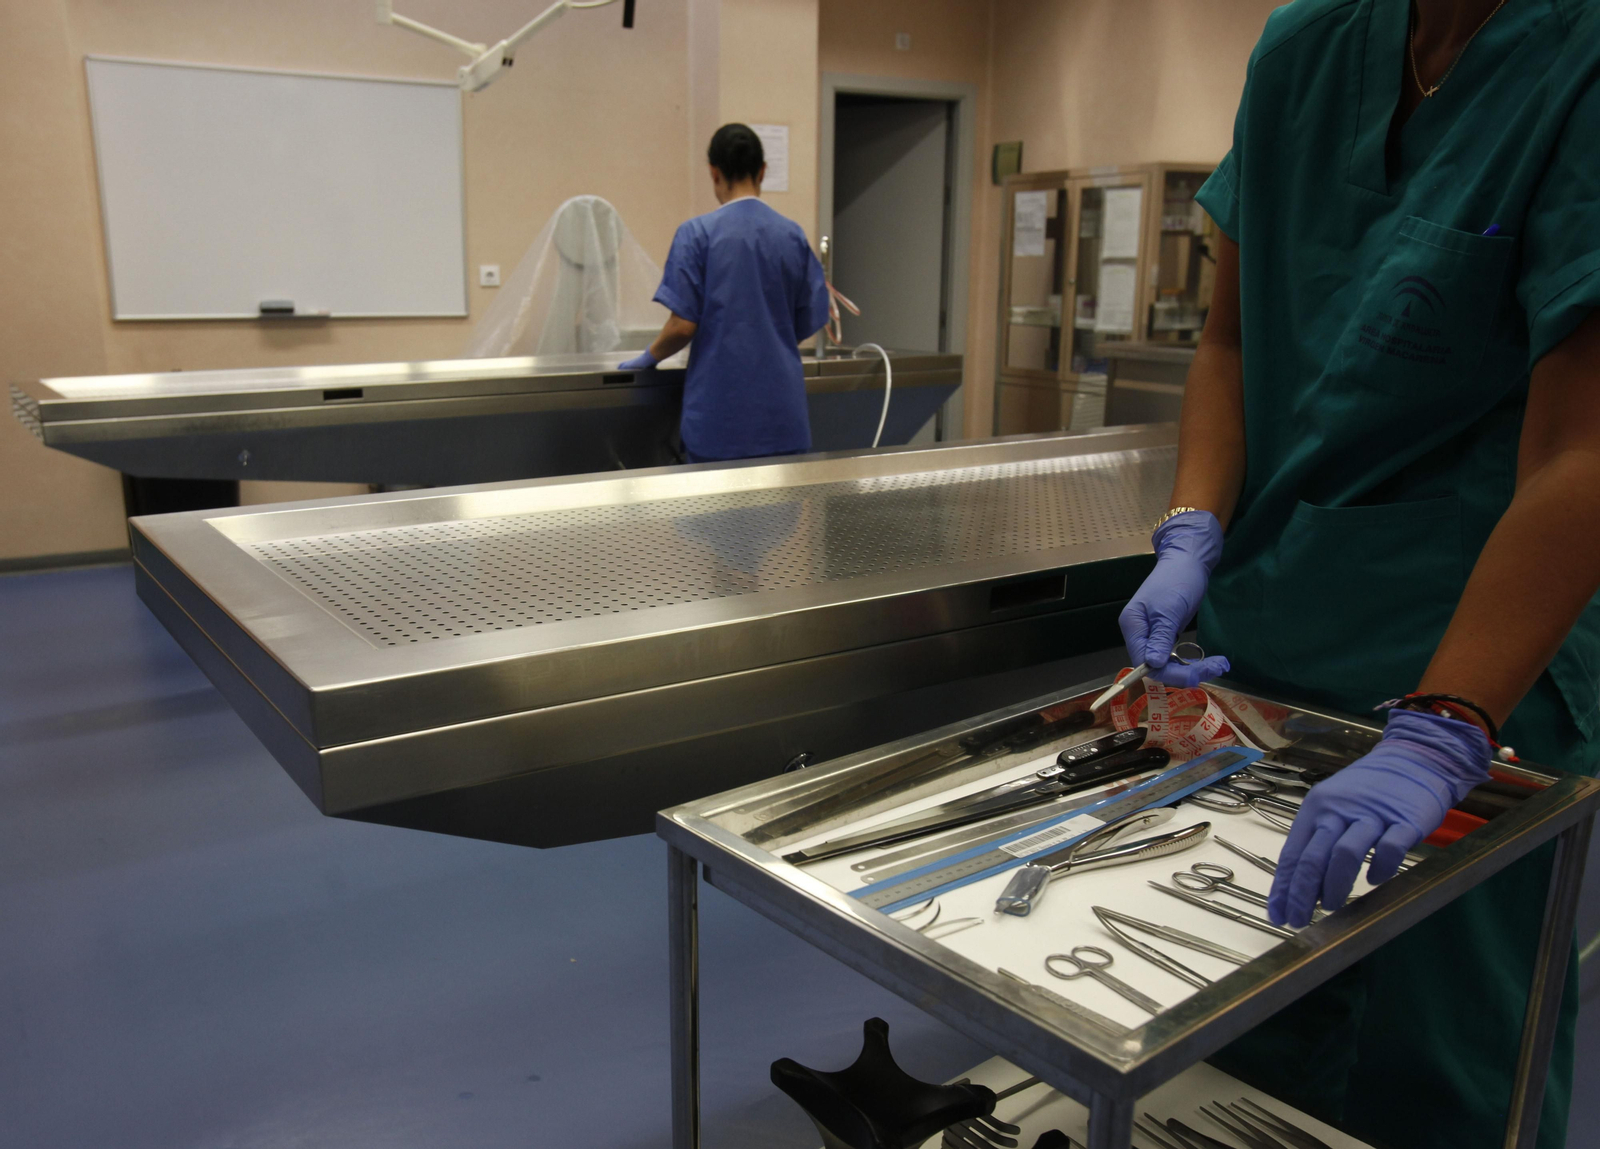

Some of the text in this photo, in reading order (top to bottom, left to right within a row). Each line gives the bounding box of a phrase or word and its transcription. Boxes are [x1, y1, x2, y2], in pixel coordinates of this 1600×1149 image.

[1358, 335, 1446, 364] VIRGEN MACARENA
[1360, 324, 1452, 354] AREA HOSPITALARIA
